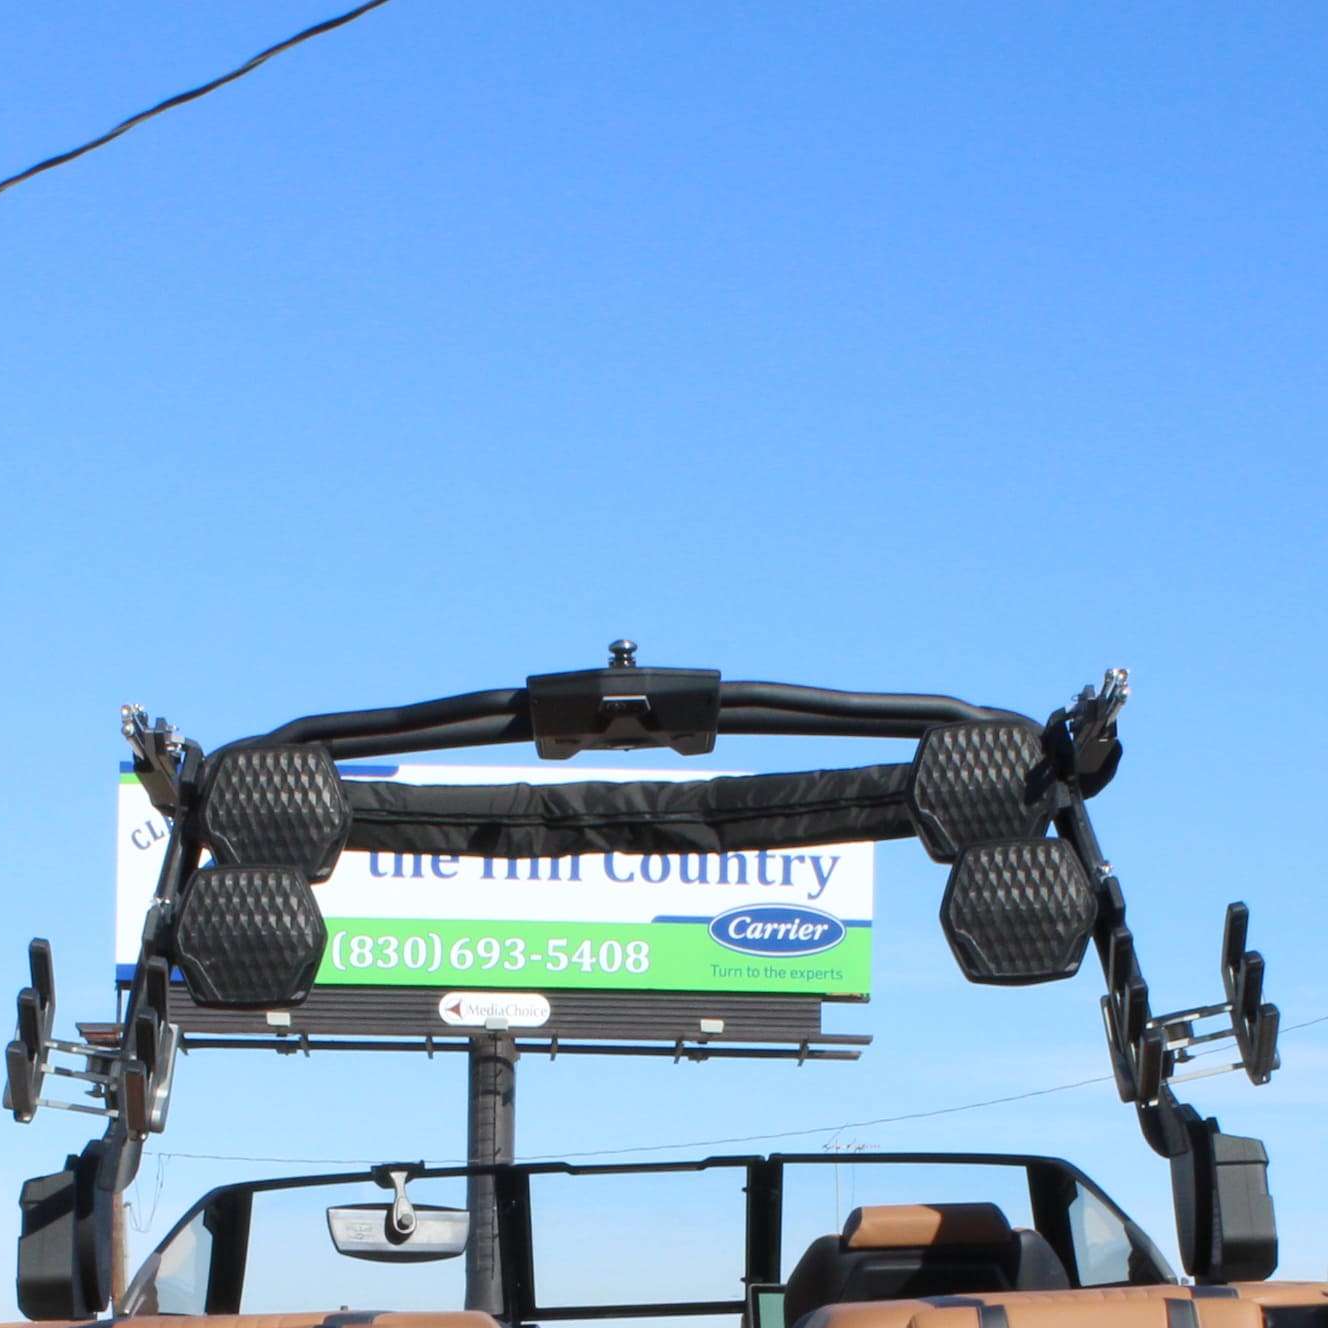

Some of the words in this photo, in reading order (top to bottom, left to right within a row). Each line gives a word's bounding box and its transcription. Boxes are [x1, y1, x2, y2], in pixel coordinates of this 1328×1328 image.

[603, 849, 841, 900] Country
[727, 915, 829, 941] Carrier
[709, 963, 743, 979] Turn
[746, 965, 761, 979] to
[763, 966, 788, 981] the
[789, 967, 844, 982] experts
[466, 1002, 549, 1017] MediaChoice
